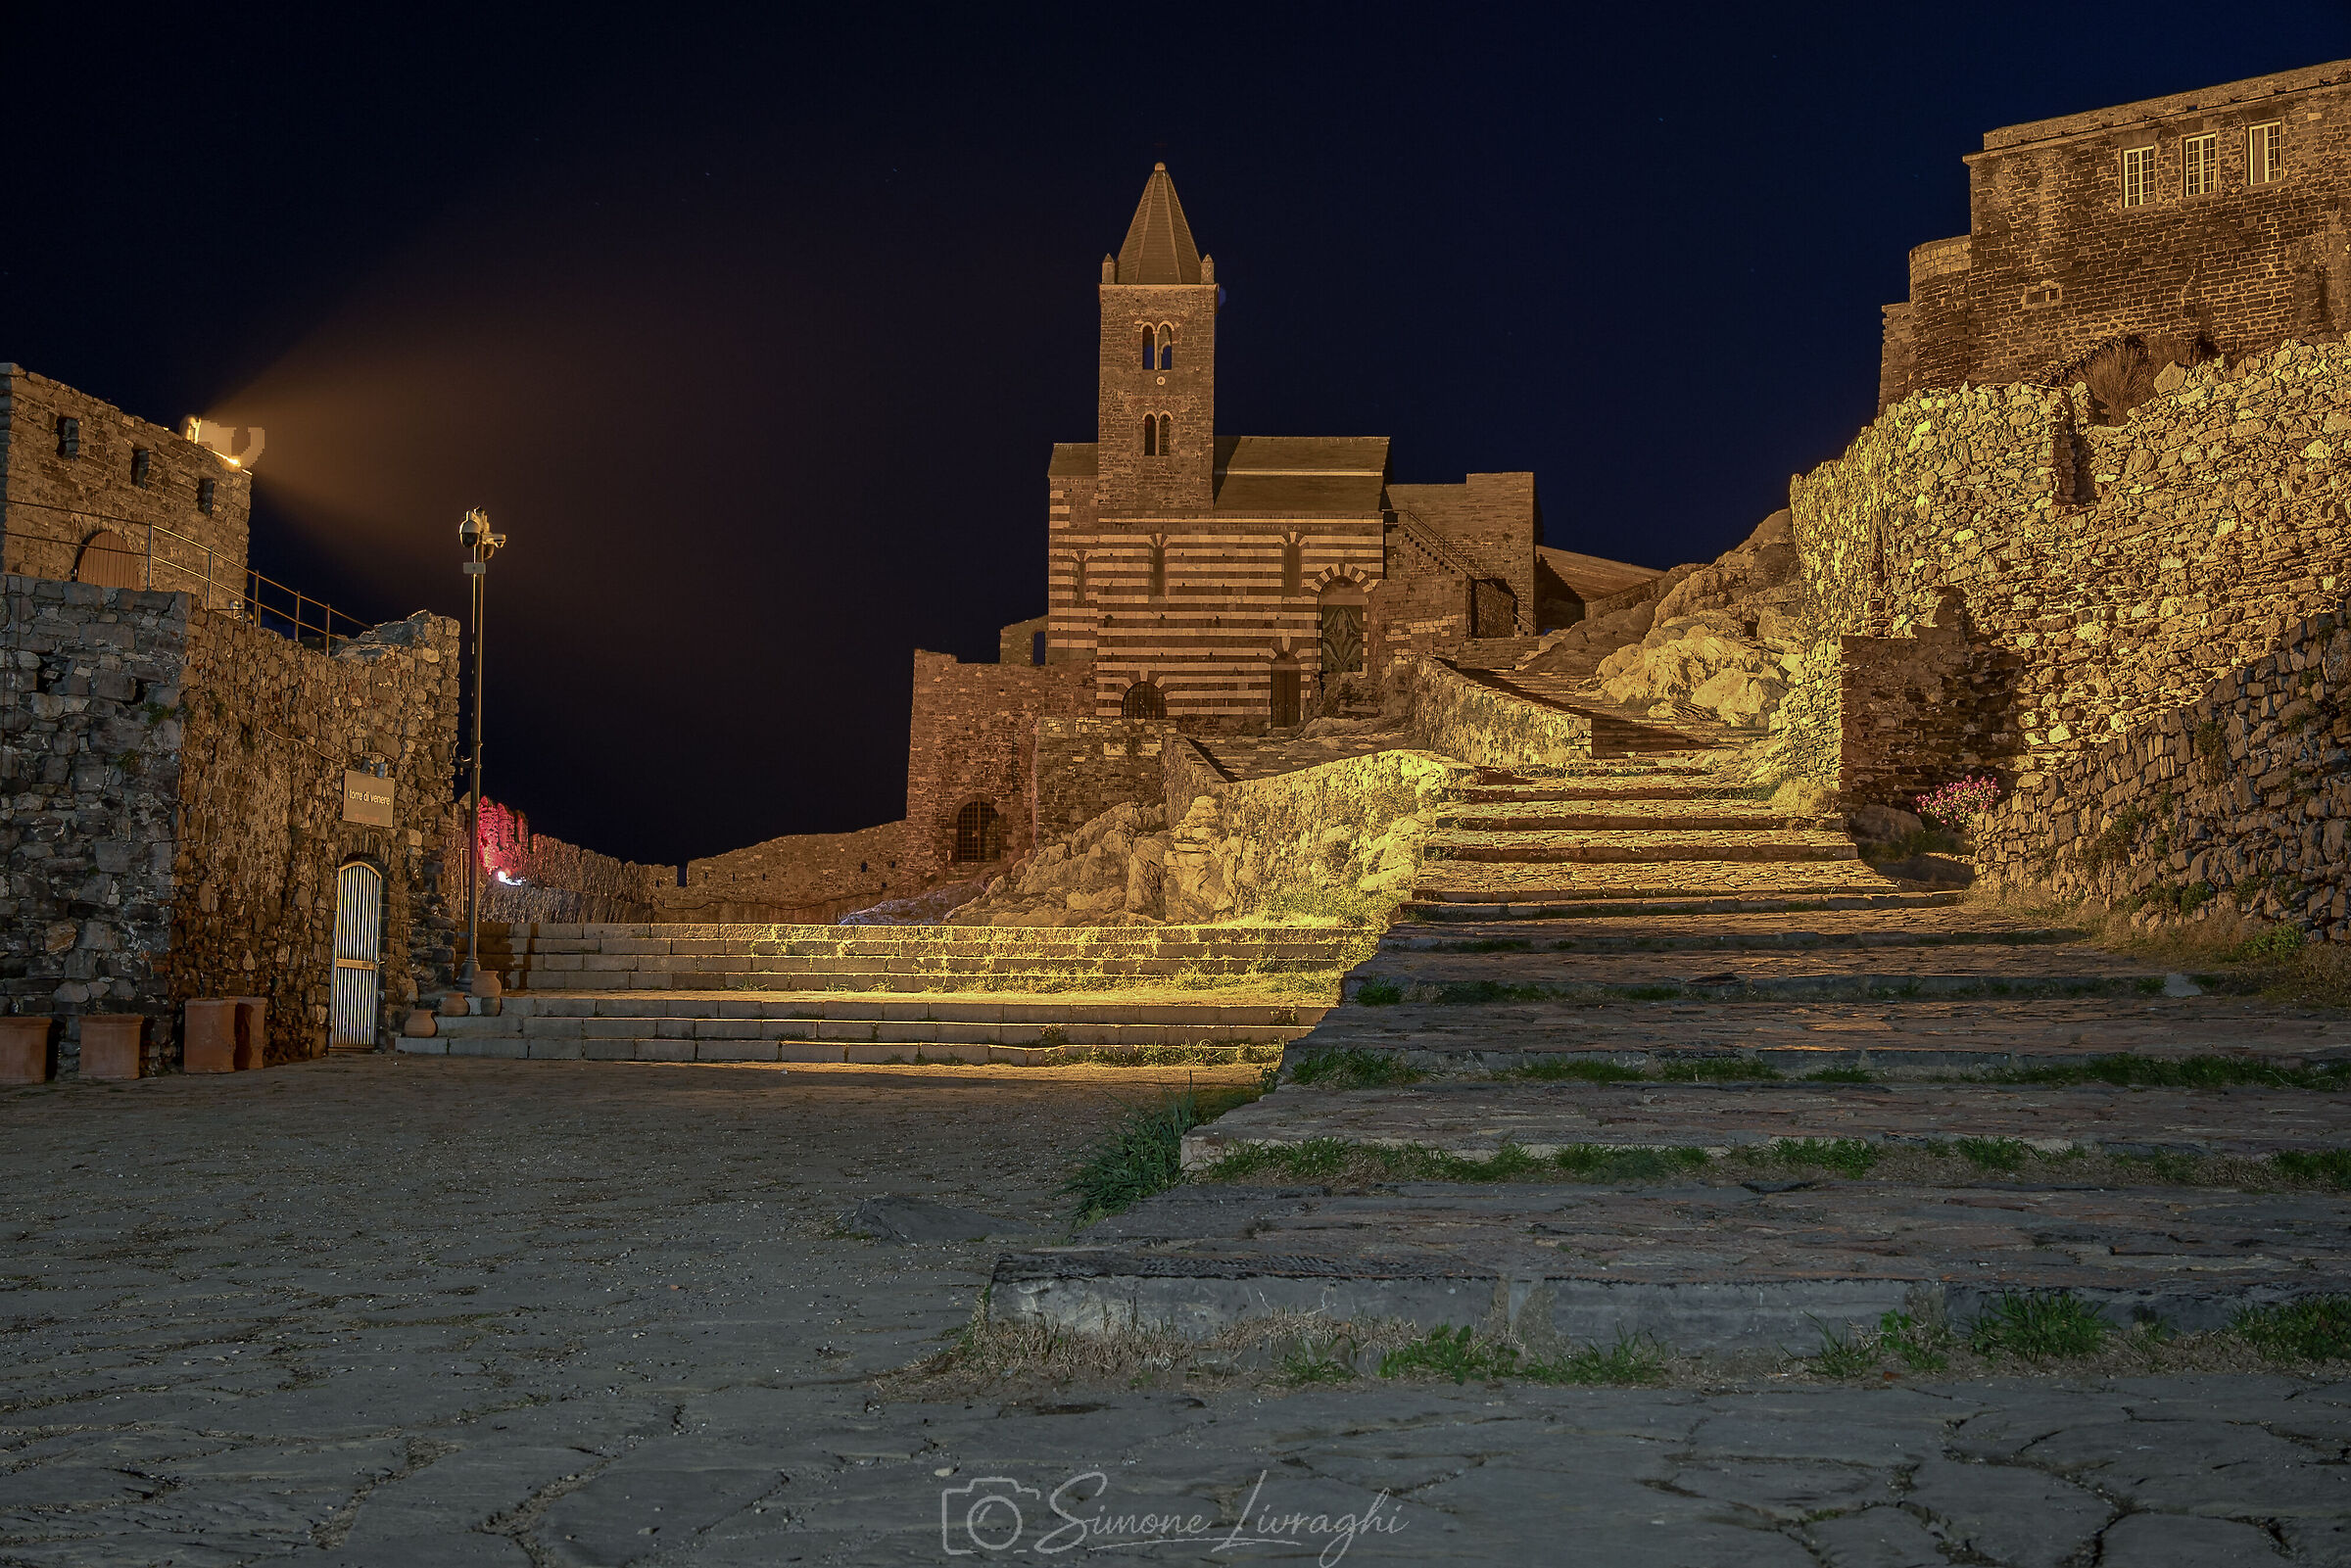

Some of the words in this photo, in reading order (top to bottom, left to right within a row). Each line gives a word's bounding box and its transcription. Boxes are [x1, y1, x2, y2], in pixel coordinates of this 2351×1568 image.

[349, 788, 362, 800] torre
[363, 790, 369, 802] di
[370, 794, 391, 806] venere
